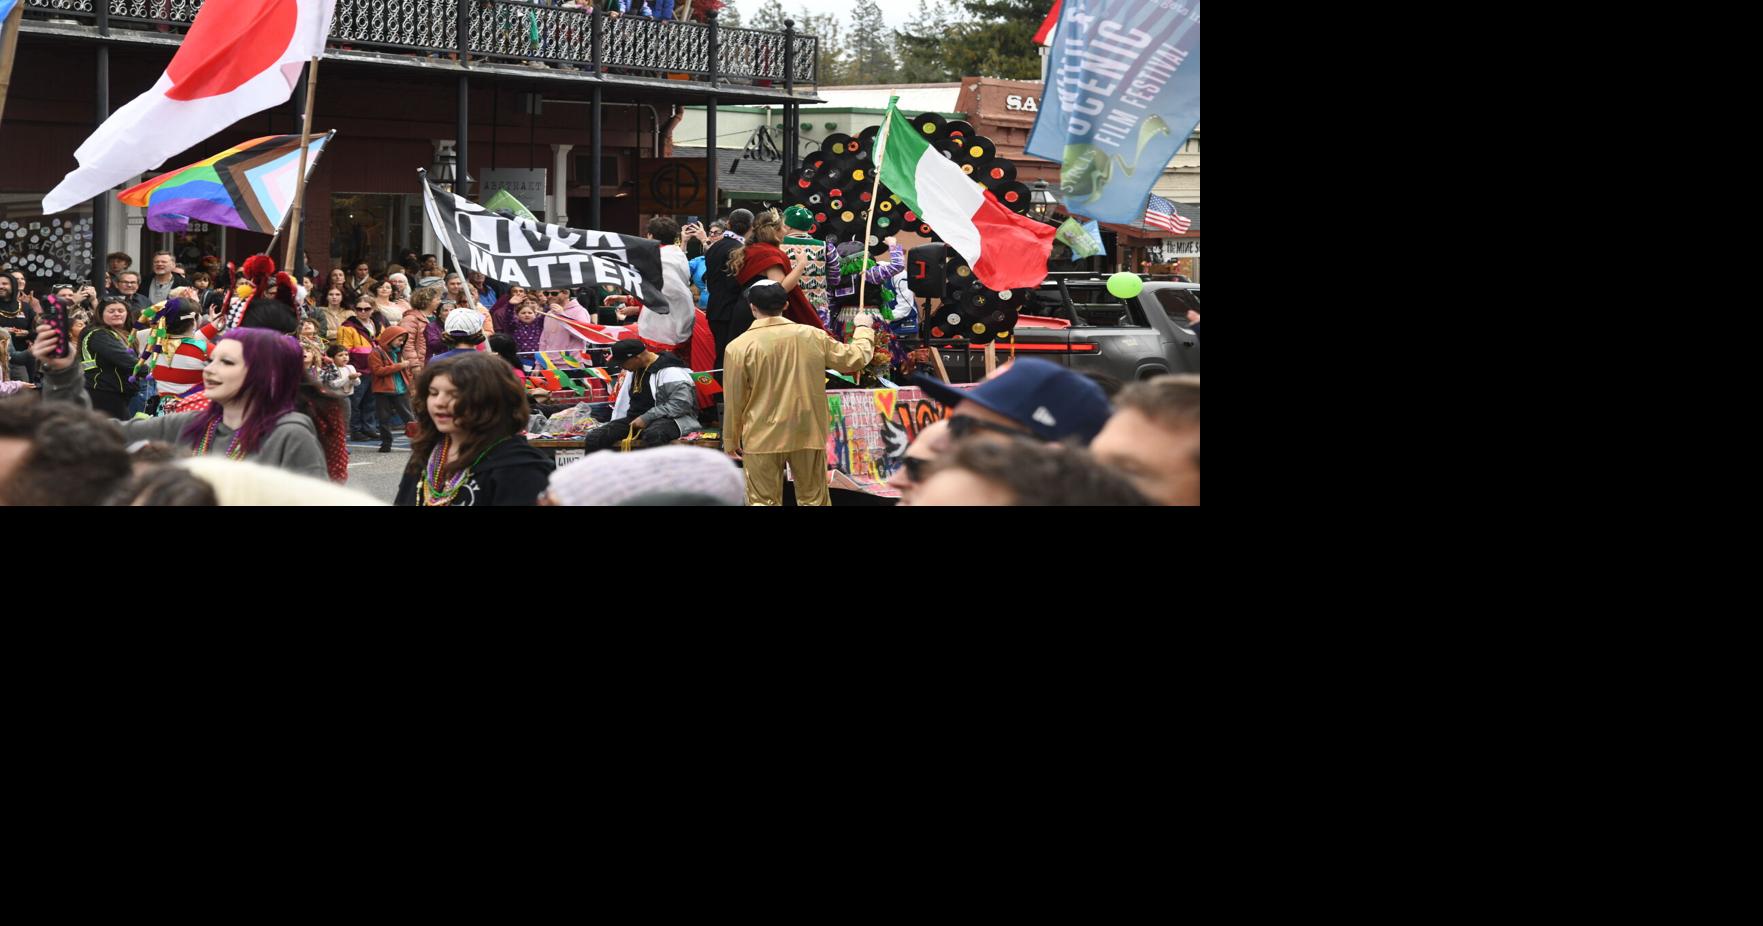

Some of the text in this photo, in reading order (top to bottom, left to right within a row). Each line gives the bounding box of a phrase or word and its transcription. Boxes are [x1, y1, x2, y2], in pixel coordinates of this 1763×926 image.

[1006, 95, 1042, 112] SA
[1094, 43, 1189, 147] FILM FESTIVAL
